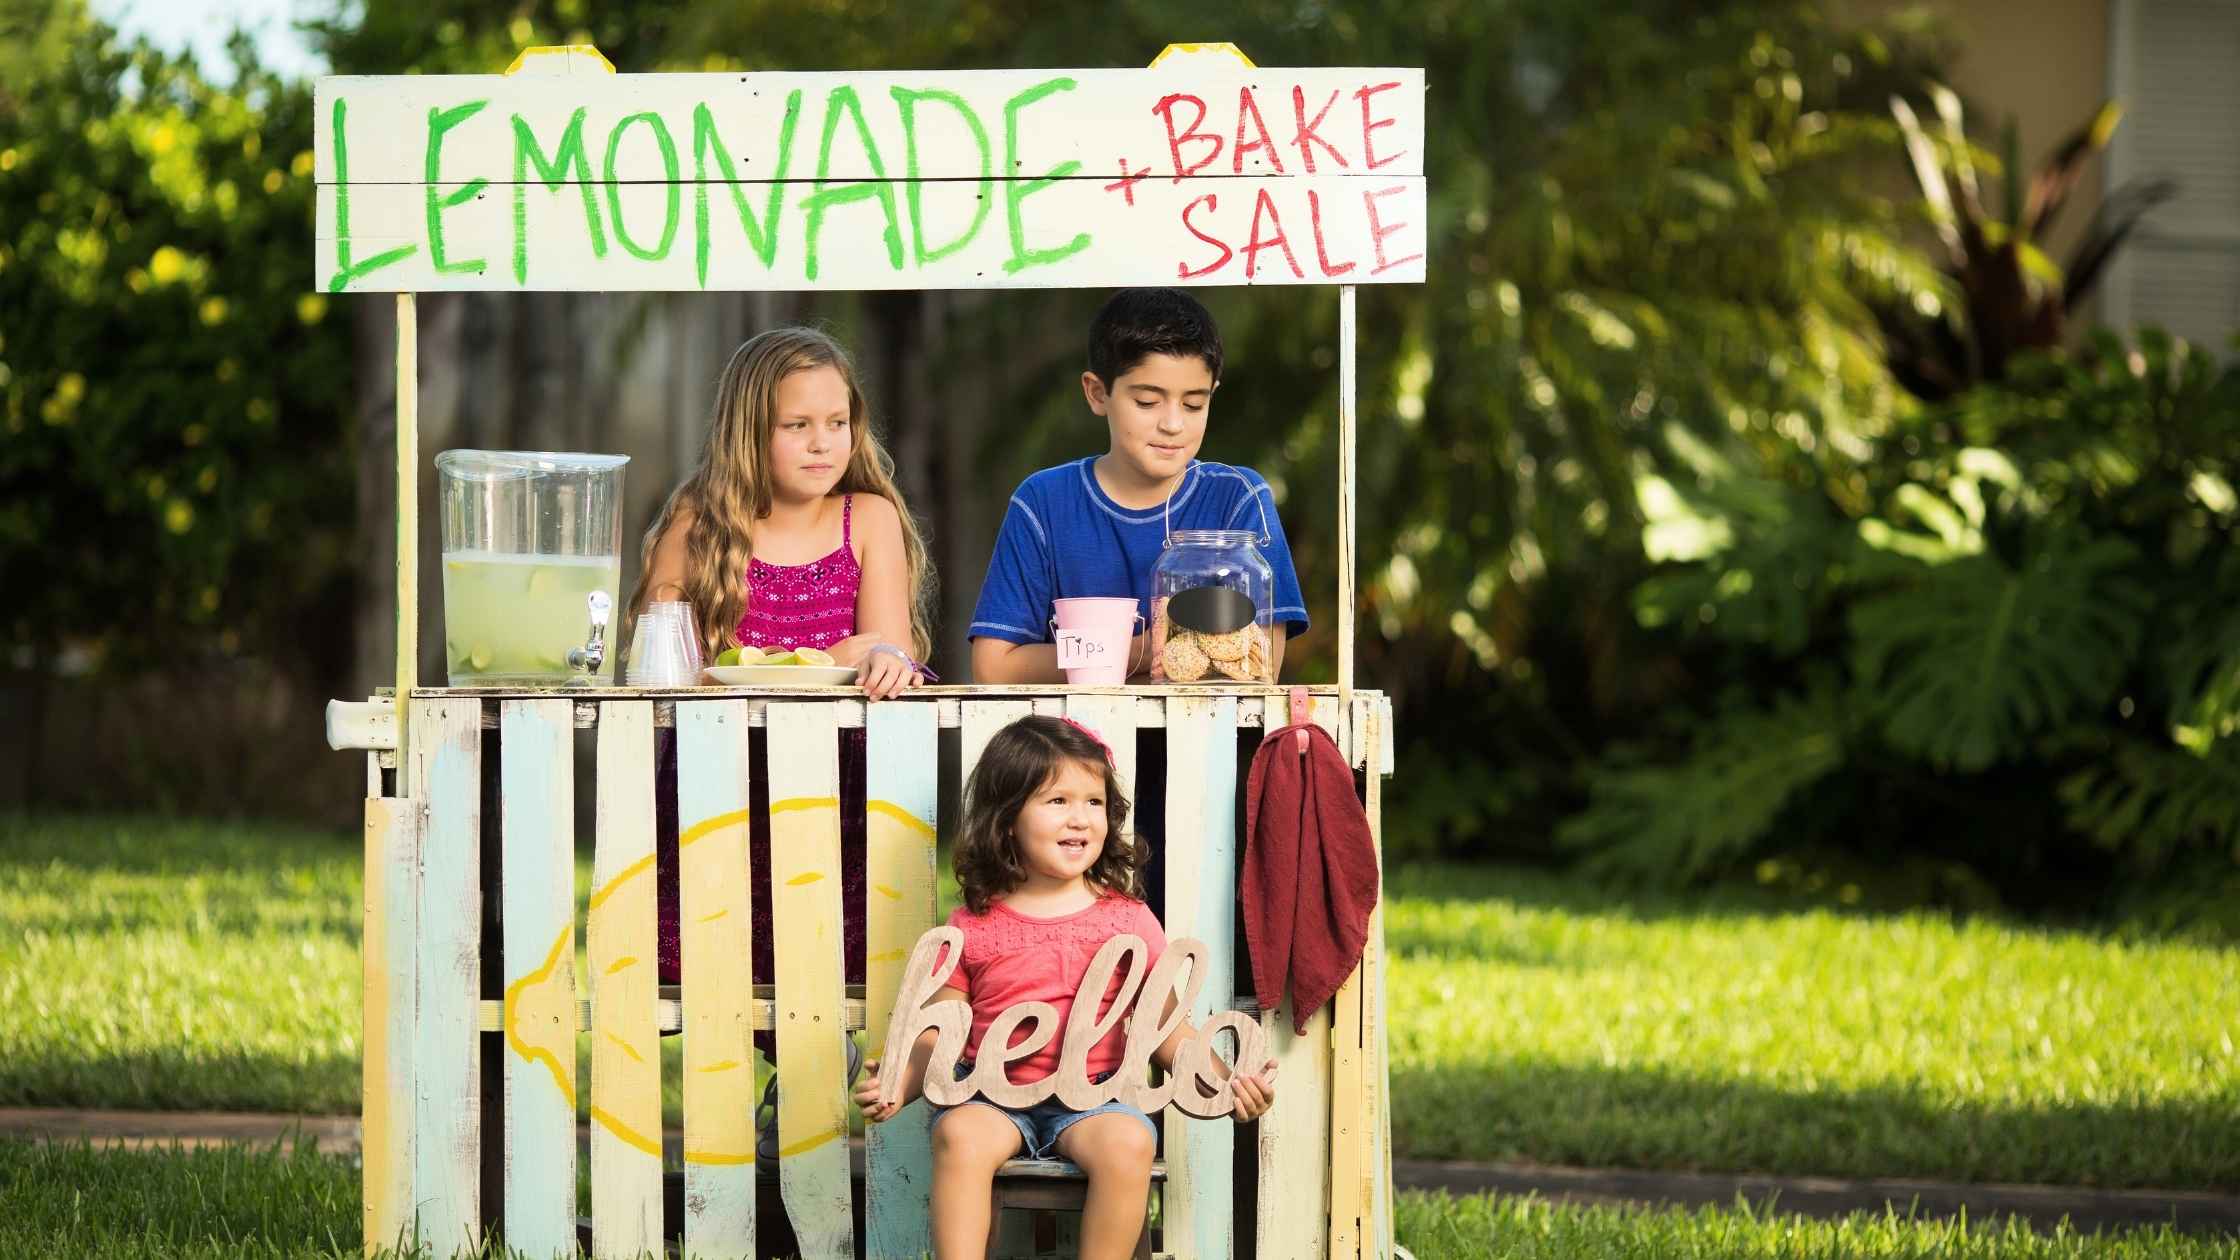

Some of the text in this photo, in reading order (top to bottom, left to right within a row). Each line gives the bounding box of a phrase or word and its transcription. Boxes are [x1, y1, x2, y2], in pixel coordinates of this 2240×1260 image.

[328, 77, 1408, 292] LEMONADE + BAKE
[1177, 186, 1423, 280] SALE
[1060, 634, 1105, 658] Tips
[878, 925, 1277, 1119] hello
